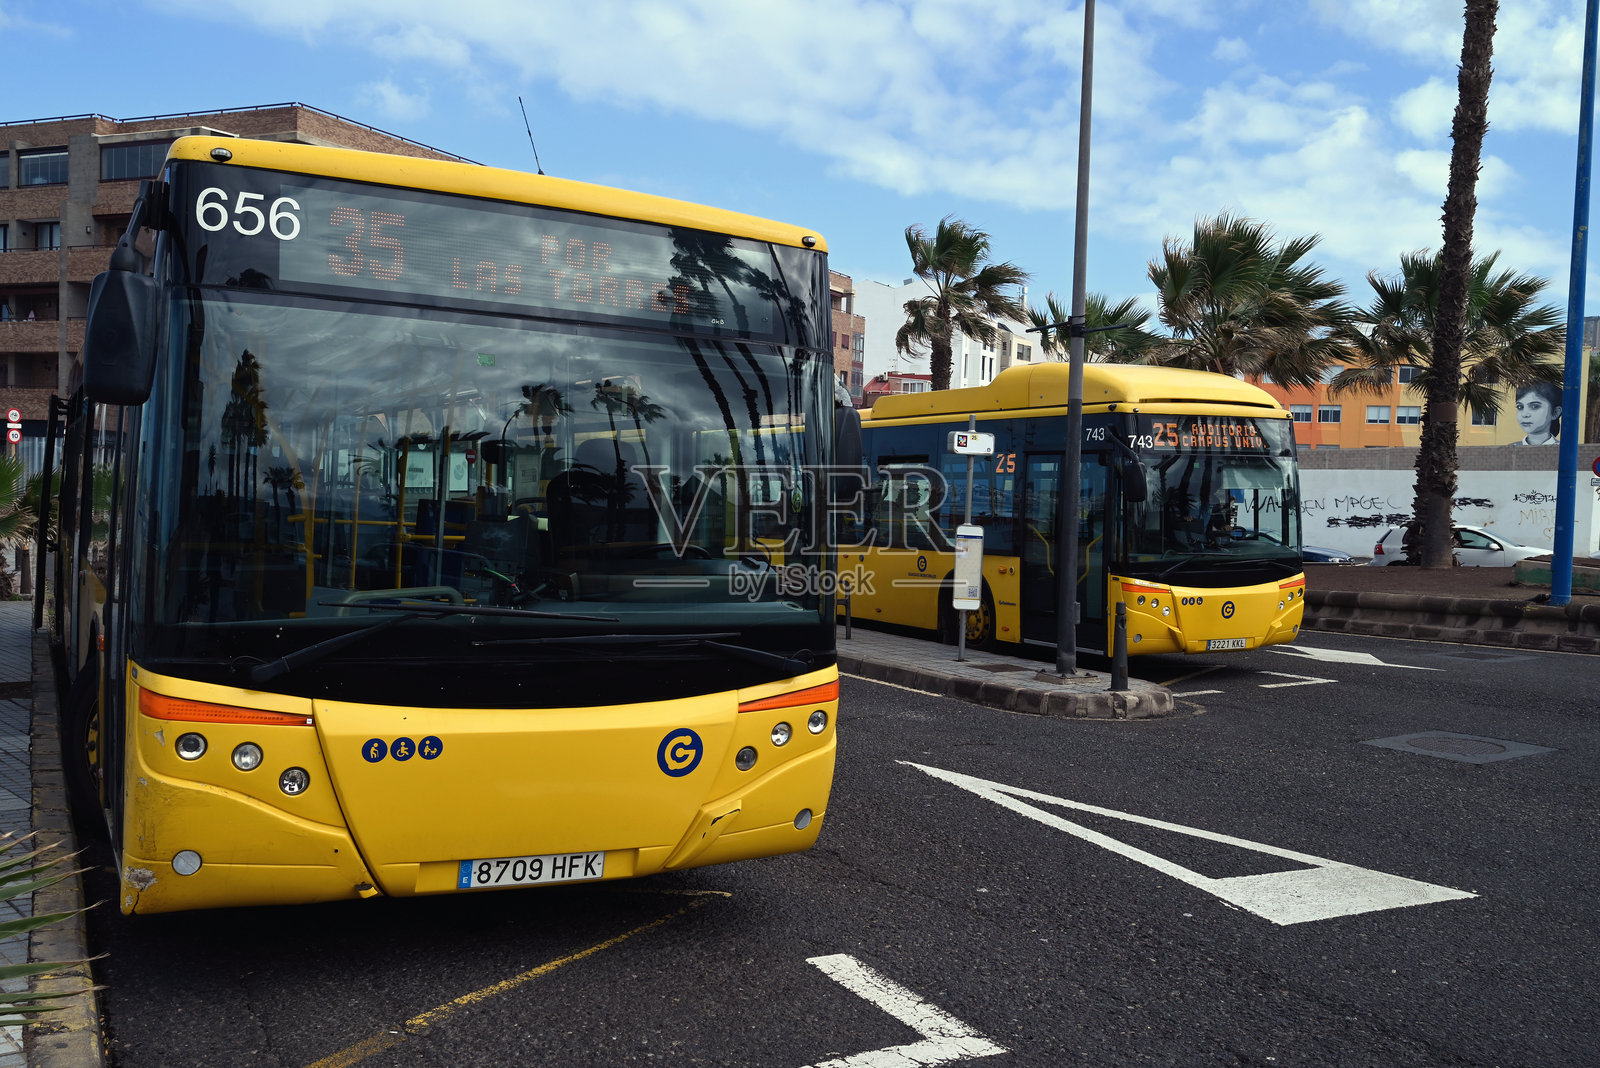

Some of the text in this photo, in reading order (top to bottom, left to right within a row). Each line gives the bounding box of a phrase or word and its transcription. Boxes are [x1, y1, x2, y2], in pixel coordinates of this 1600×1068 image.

[195, 187, 301, 241] 656
[328, 205, 406, 282] 35
[540, 233, 612, 273] POR
[452, 256, 691, 315] LAS TORRES
[1085, 427, 1105, 441] 743
[1128, 435, 1154, 449] 743
[1152, 422, 1257, 447] 25 AUDITORIO
[1182, 436, 1268, 449] CAMPUS UNIV.
[995, 453, 1017, 473] 25
[1211, 640, 1230, 649] 3221
[476, 858, 544, 885] 8709
[551, 853, 599, 879] HFK
